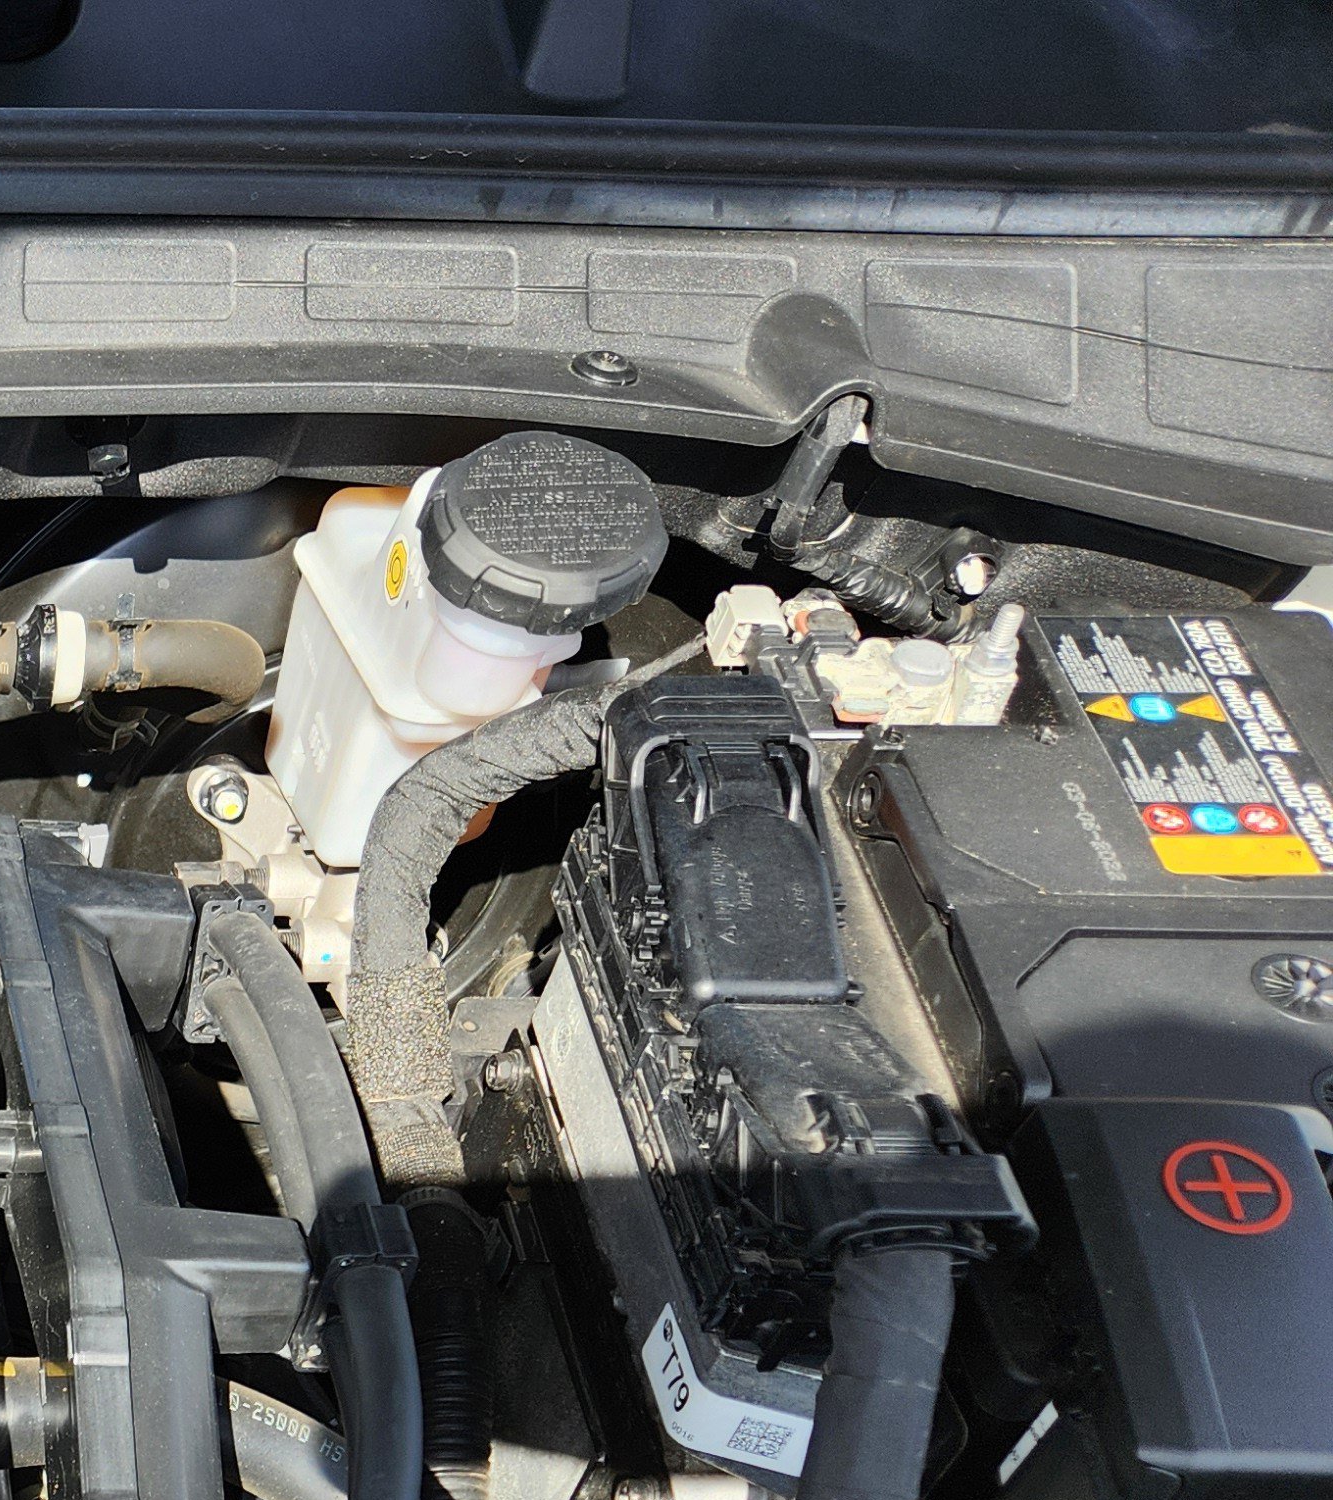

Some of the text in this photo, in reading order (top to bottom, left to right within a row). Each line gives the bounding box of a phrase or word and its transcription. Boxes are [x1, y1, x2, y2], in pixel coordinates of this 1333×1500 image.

[1200, 649, 1231, 676] CCA
[1271, 731, 1301, 752] RC
[662, 1342, 690, 1413] T79
